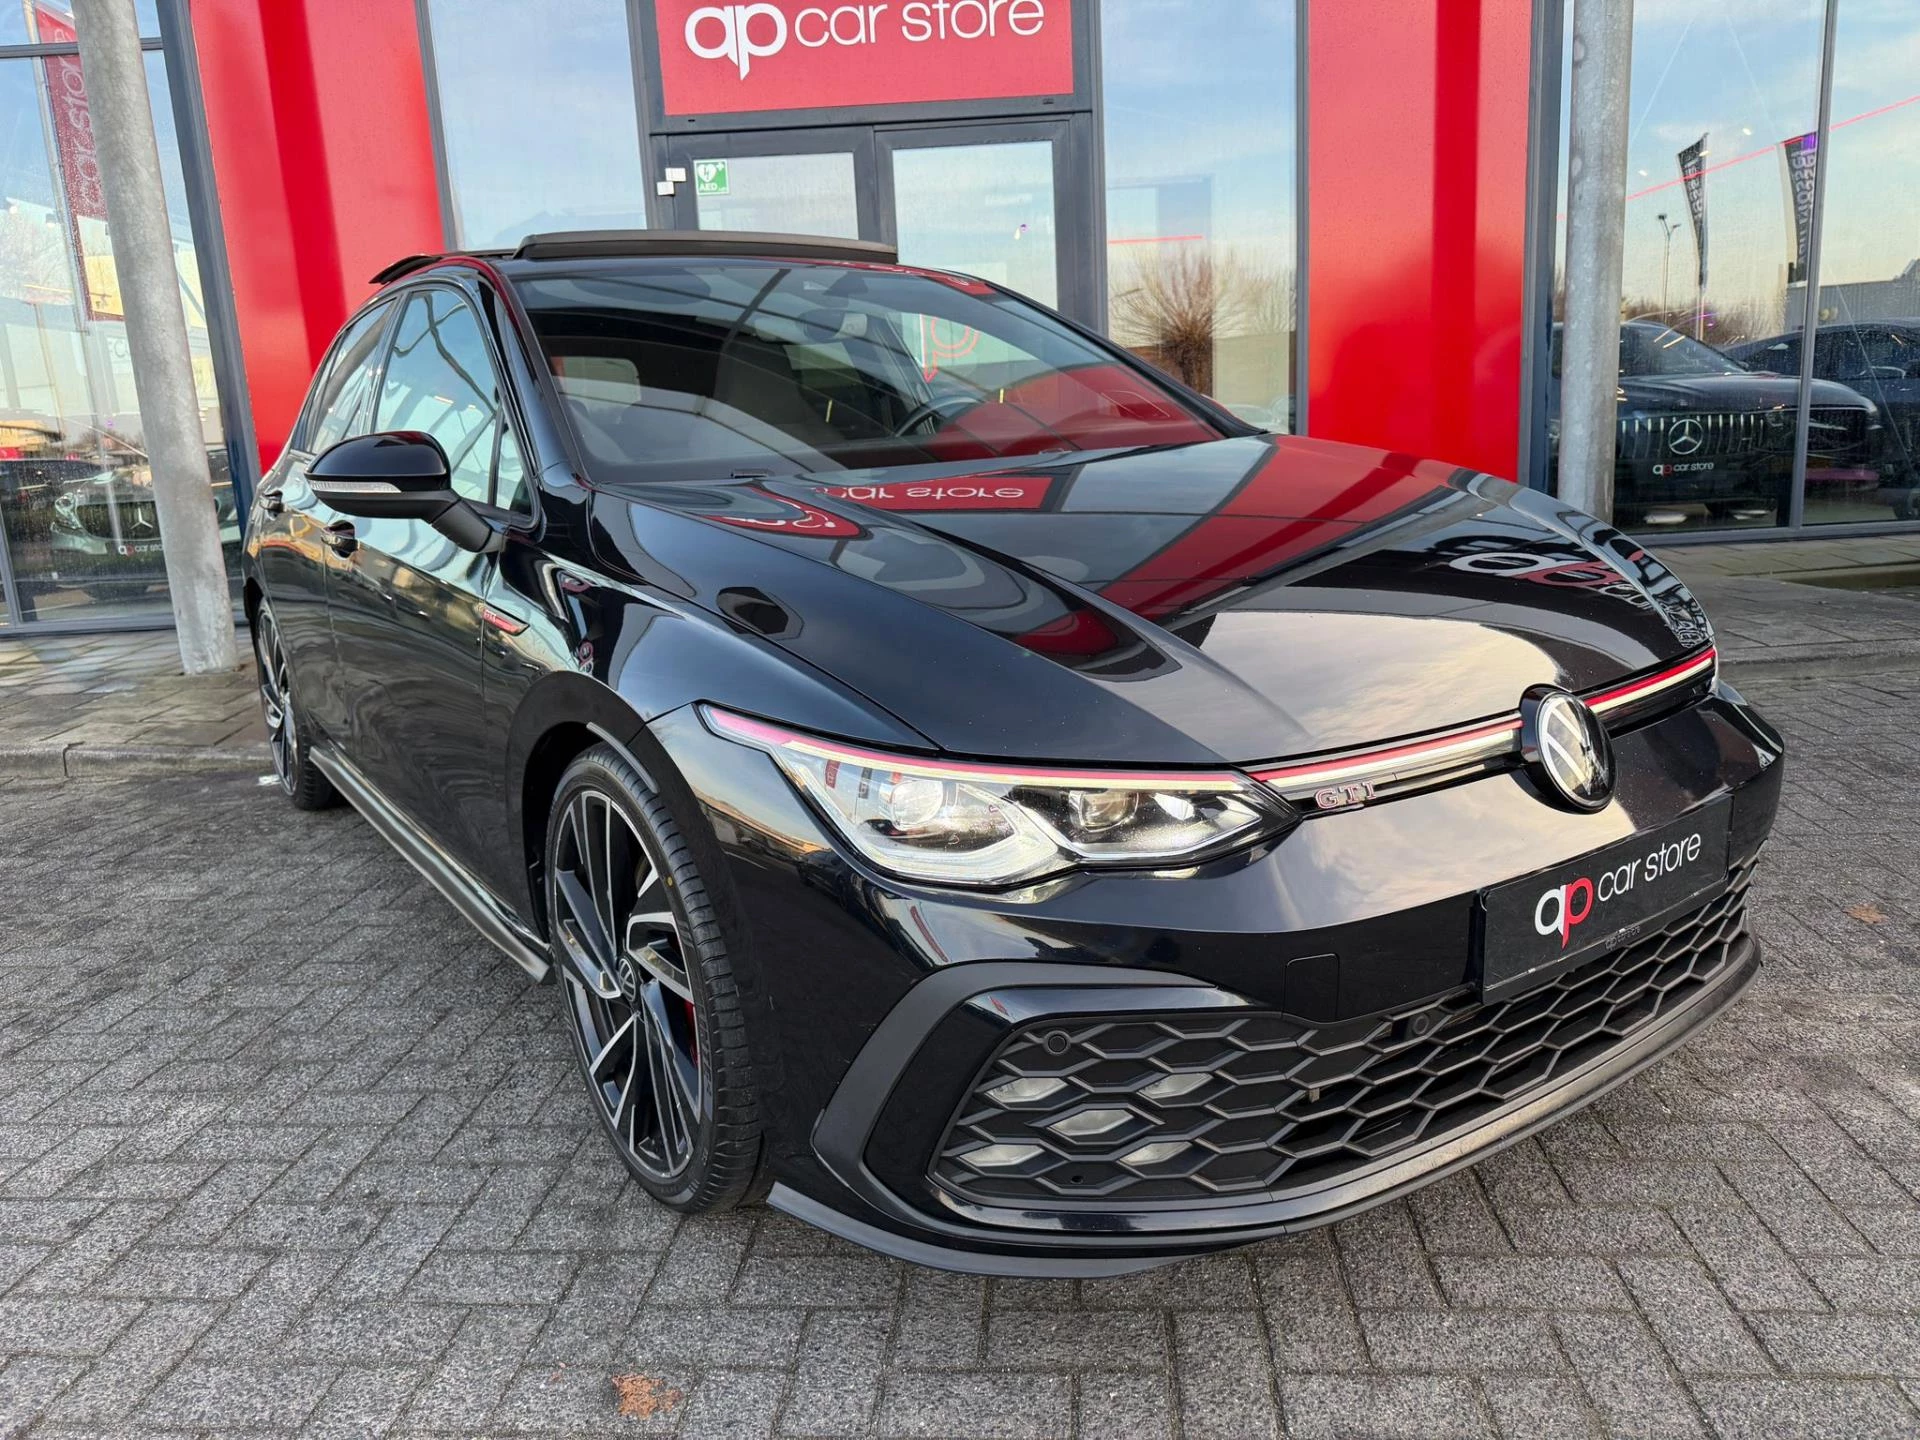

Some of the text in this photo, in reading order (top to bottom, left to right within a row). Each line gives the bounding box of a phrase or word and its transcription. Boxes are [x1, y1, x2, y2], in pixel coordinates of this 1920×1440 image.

[685, 0, 1045, 80] ap car store
[699, 182, 718, 192] AED
[1673, 463, 1690, 471] car
[1691, 462, 1714, 470] store
[1315, 780, 1377, 809] GTI
[1597, 858, 1642, 902] car
[1644, 833, 1701, 882] store
